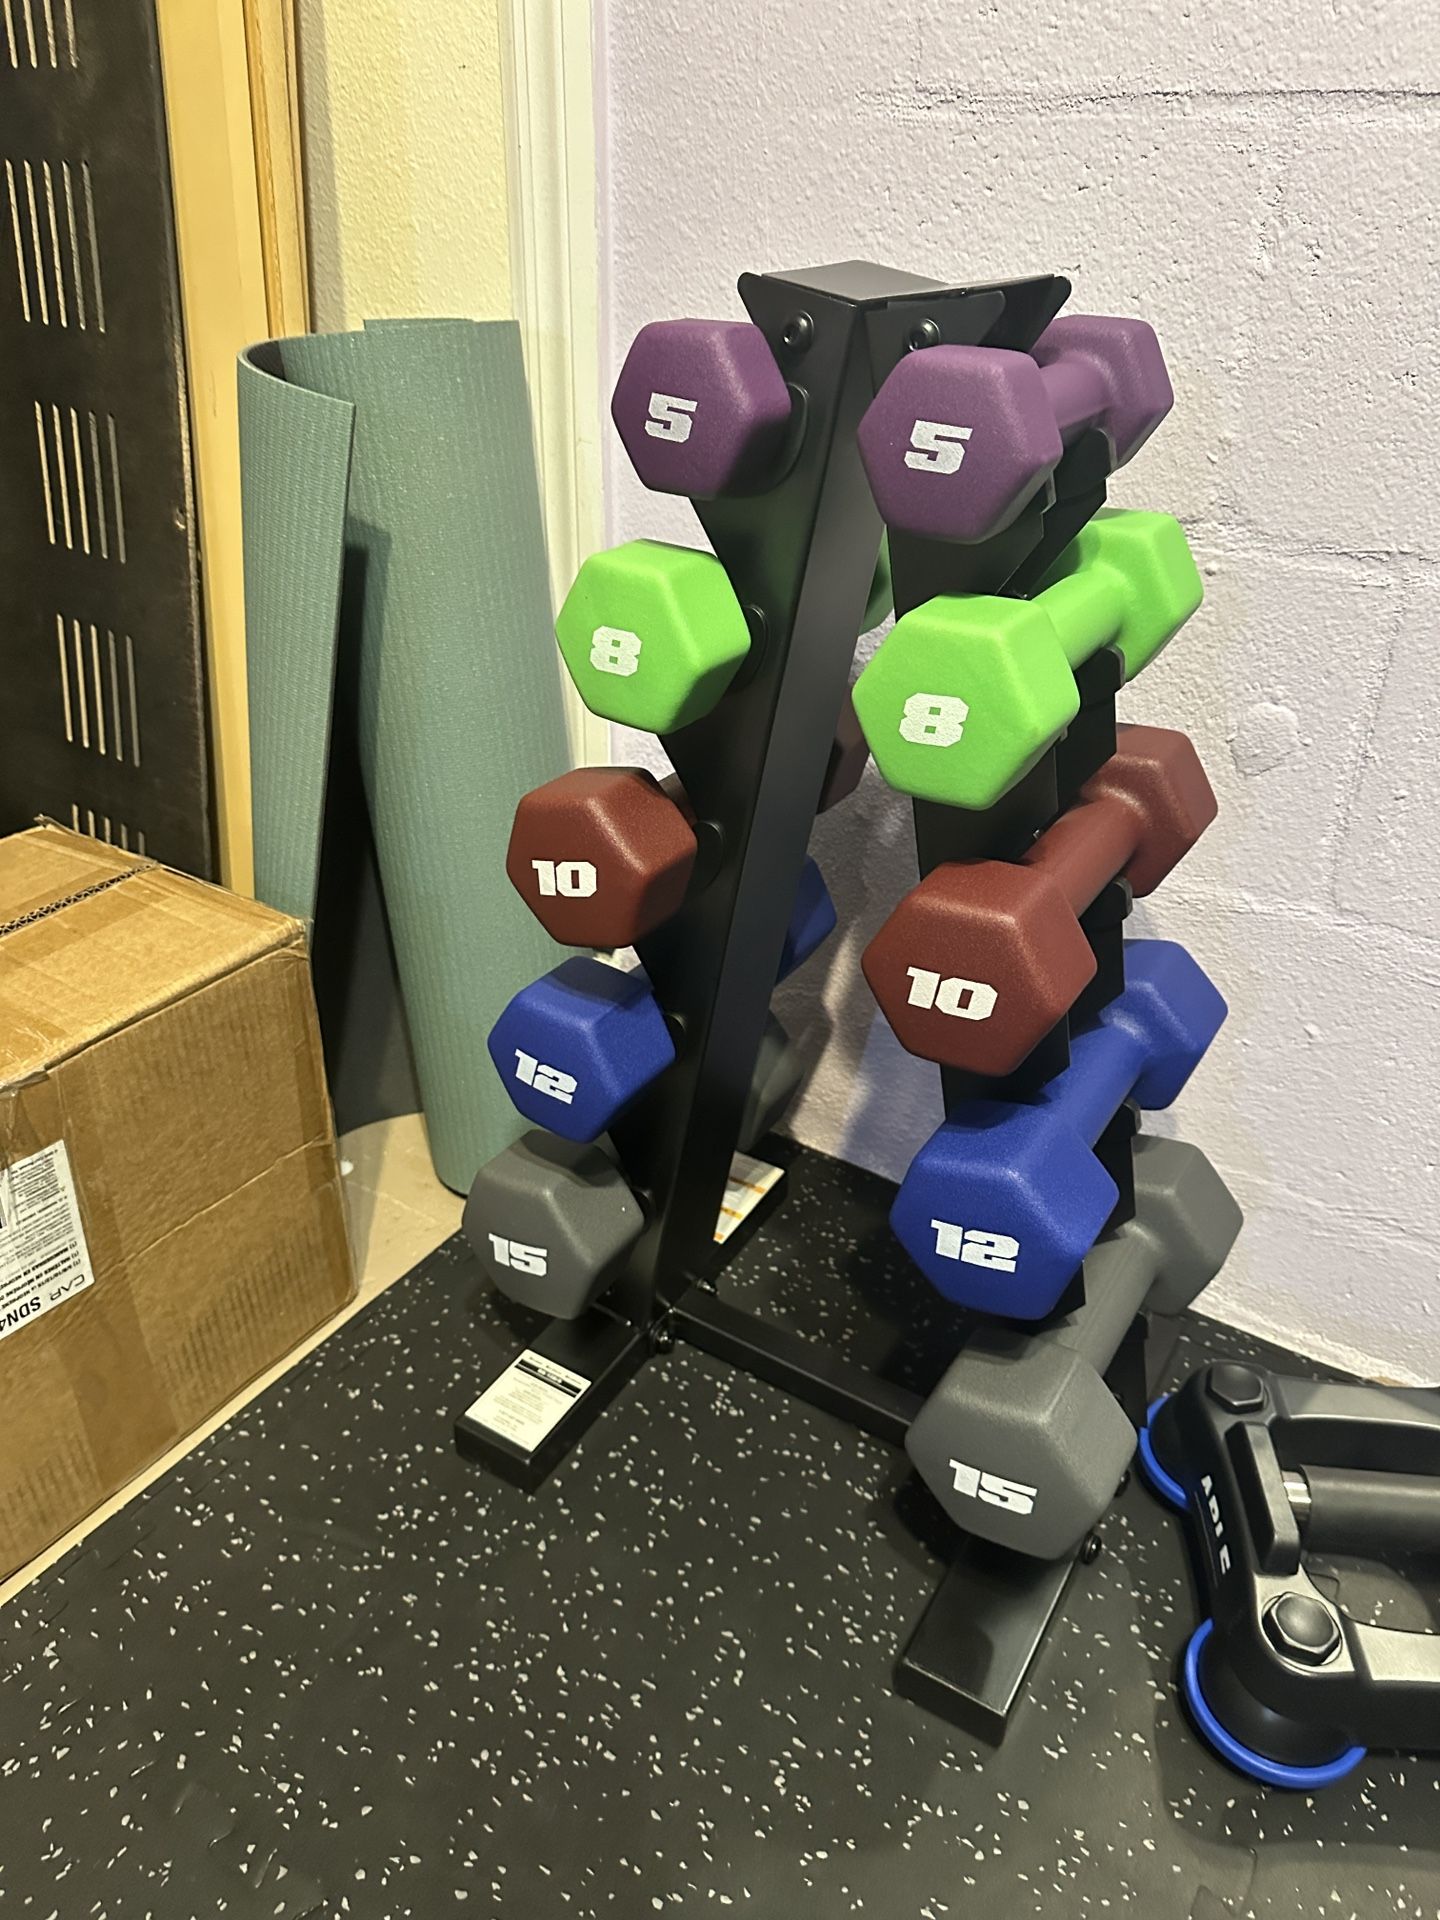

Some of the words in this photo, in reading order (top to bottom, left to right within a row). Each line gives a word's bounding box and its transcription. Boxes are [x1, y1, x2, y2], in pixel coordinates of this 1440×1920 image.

[645, 393, 698, 443] 5
[904, 420, 974, 475] 5
[590, 626, 643, 677] 8
[899, 693, 970, 748] 8
[532, 860, 598, 898] 10
[907, 967, 998, 1021] 10
[515, 1049, 578, 1105] 12
[489, 1234, 548, 1277] 15
[931, 1220, 1020, 1273] 12
[950, 1459, 1038, 1515] 15
